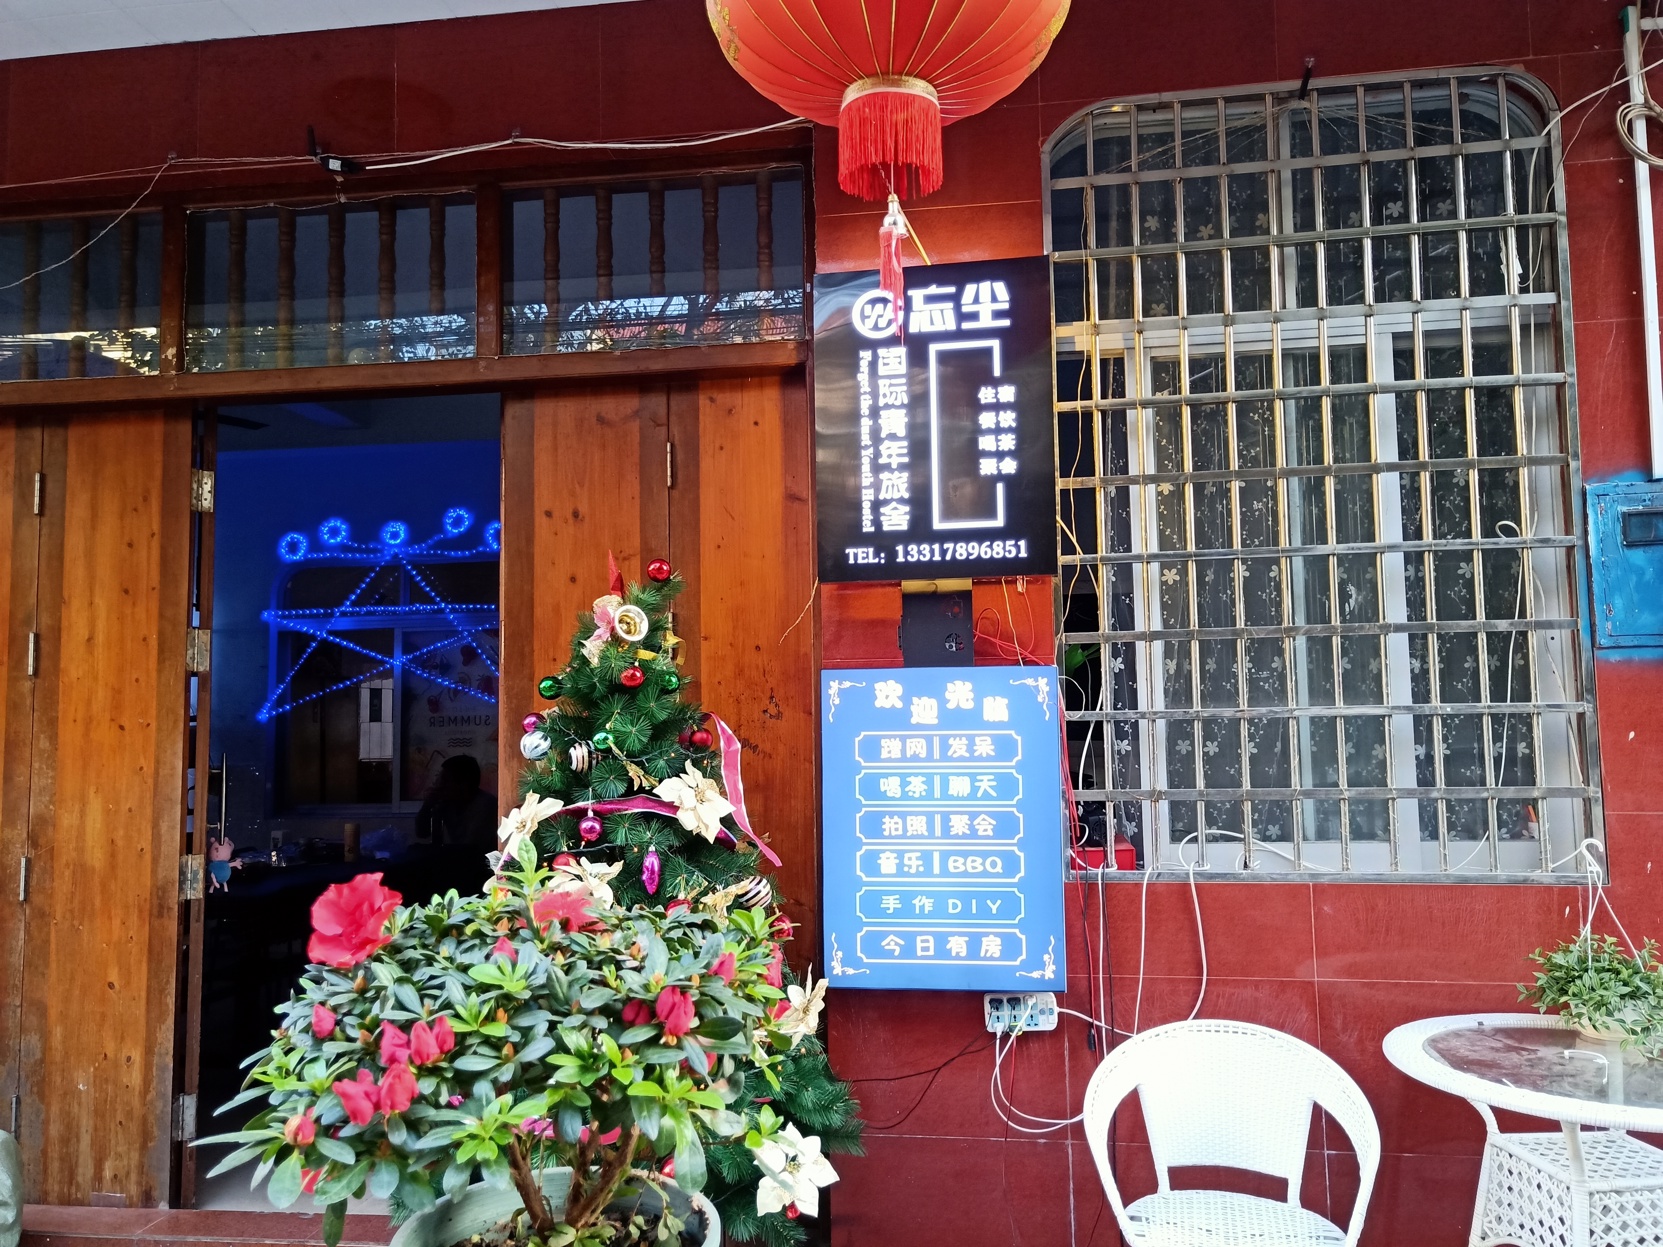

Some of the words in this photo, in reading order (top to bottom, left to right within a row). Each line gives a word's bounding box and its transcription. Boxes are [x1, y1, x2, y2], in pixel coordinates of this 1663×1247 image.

[908, 281, 1010, 333] 忘尘
[857, 350, 872, 393] Forget
[861, 394, 873, 416] the
[861, 417, 873, 447] dust
[877, 346, 910, 531] 国际青年旅舍
[861, 447, 874, 487] Youth
[861, 488, 875, 532] Hostel
[895, 540, 1028, 562] 13317896851
[873, 679, 1009, 725] 欢迎光临
[880, 736, 927, 759] 蹭网
[947, 736, 996, 758] 发呆
[879, 775, 928, 798] 喝茶
[948, 775, 998, 797] 聊天
[882, 815, 928, 836] 拍照
[949, 814, 997, 837] 聚会
[877, 851, 925, 874] 音乐
[948, 856, 1003, 873] BBQ
[880, 895, 934, 915] 手作
[947, 899, 1002, 914] DIY
[881, 934, 1002, 958] 今日有房
